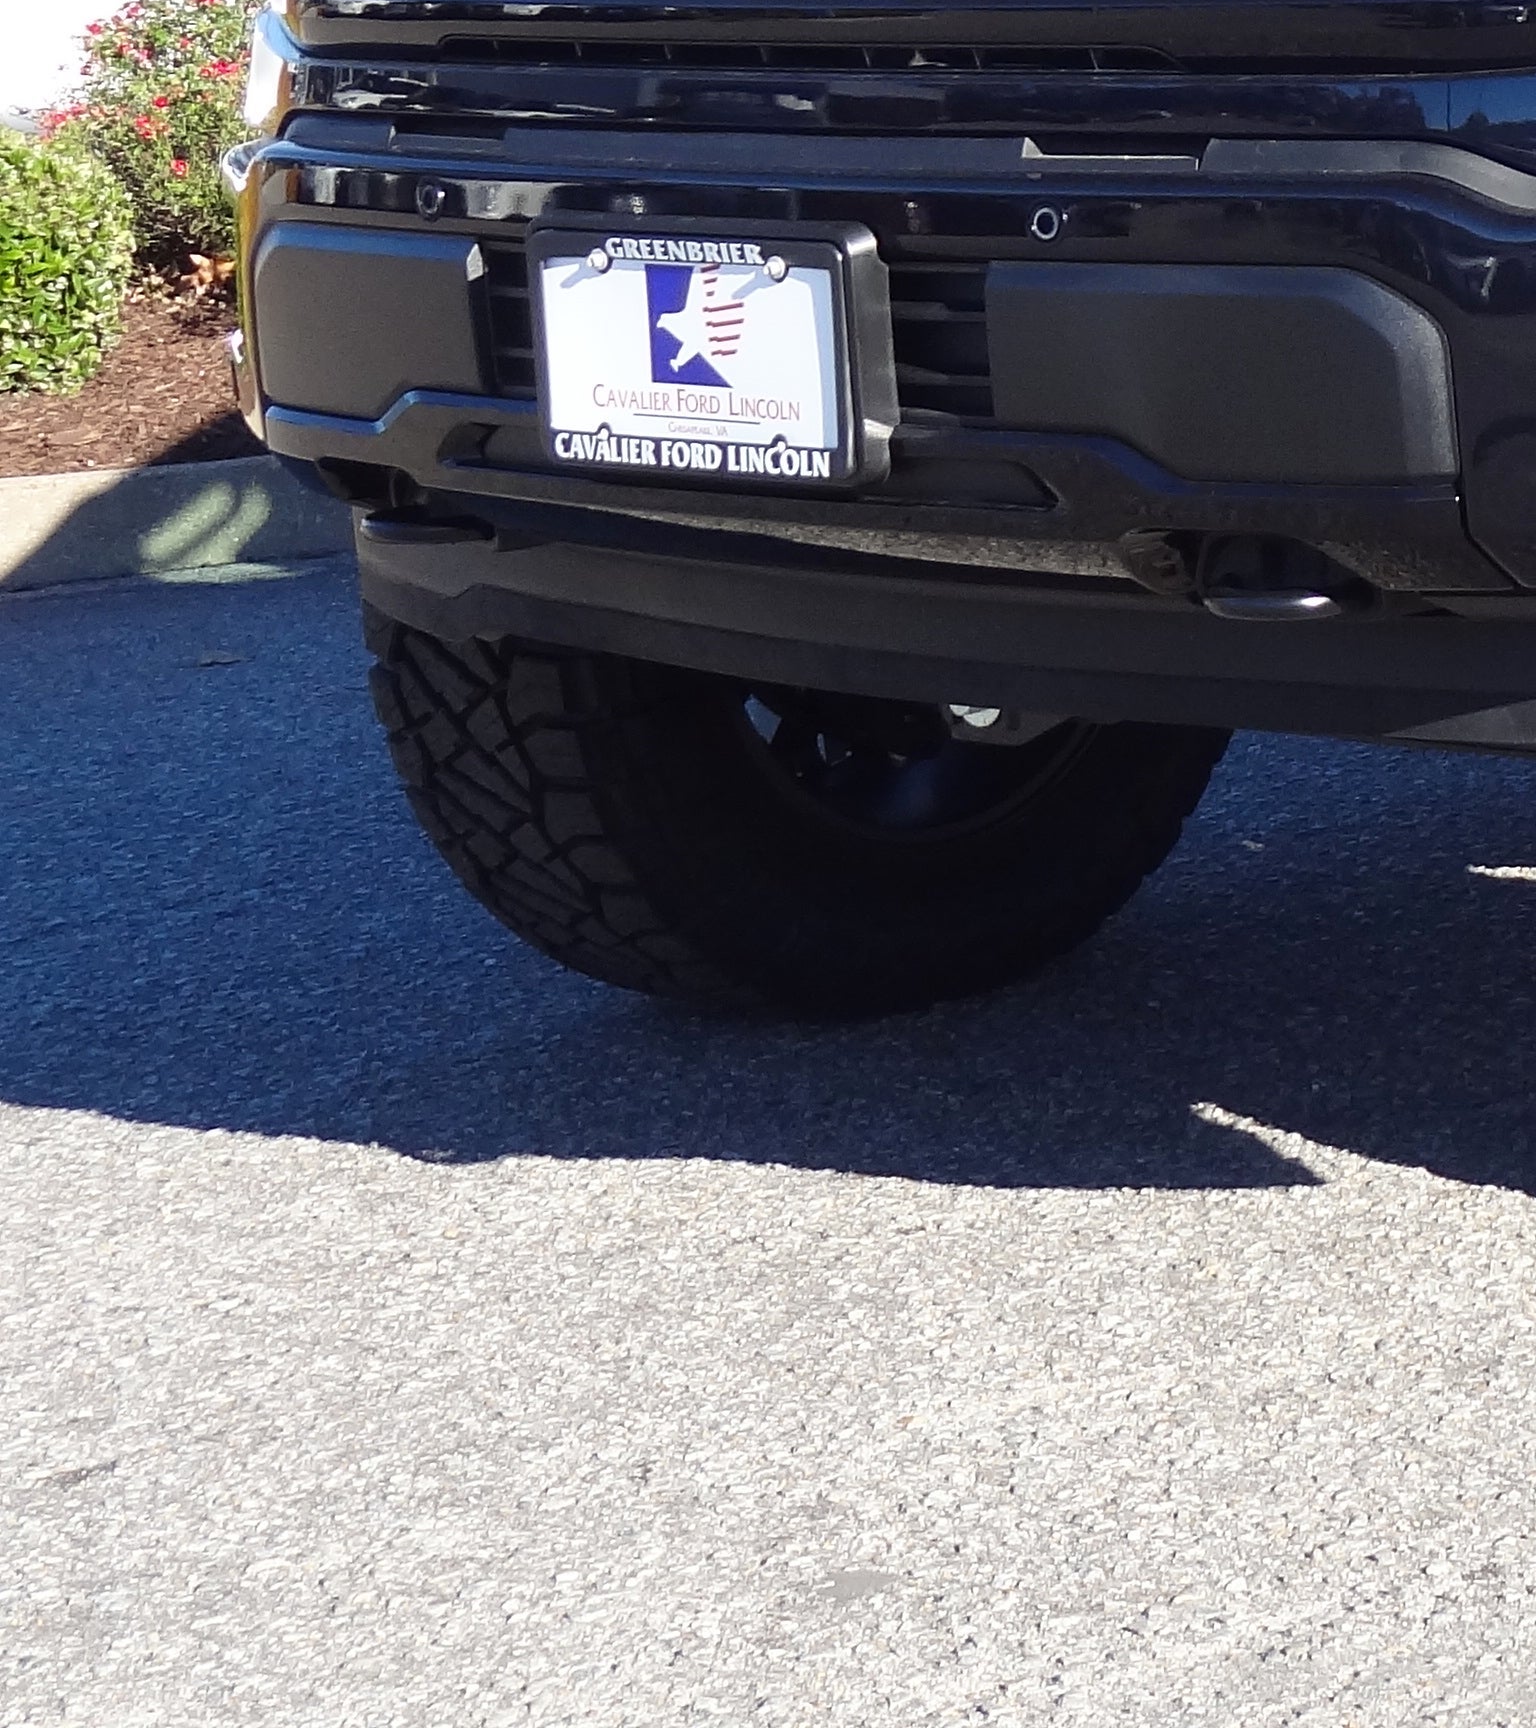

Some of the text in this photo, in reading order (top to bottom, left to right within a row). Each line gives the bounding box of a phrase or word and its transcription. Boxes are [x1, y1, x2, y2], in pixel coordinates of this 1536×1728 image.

[605, 237, 765, 265] GREENBRIER
[554, 431, 831, 478] CAVALIER FORD LINCOLN
